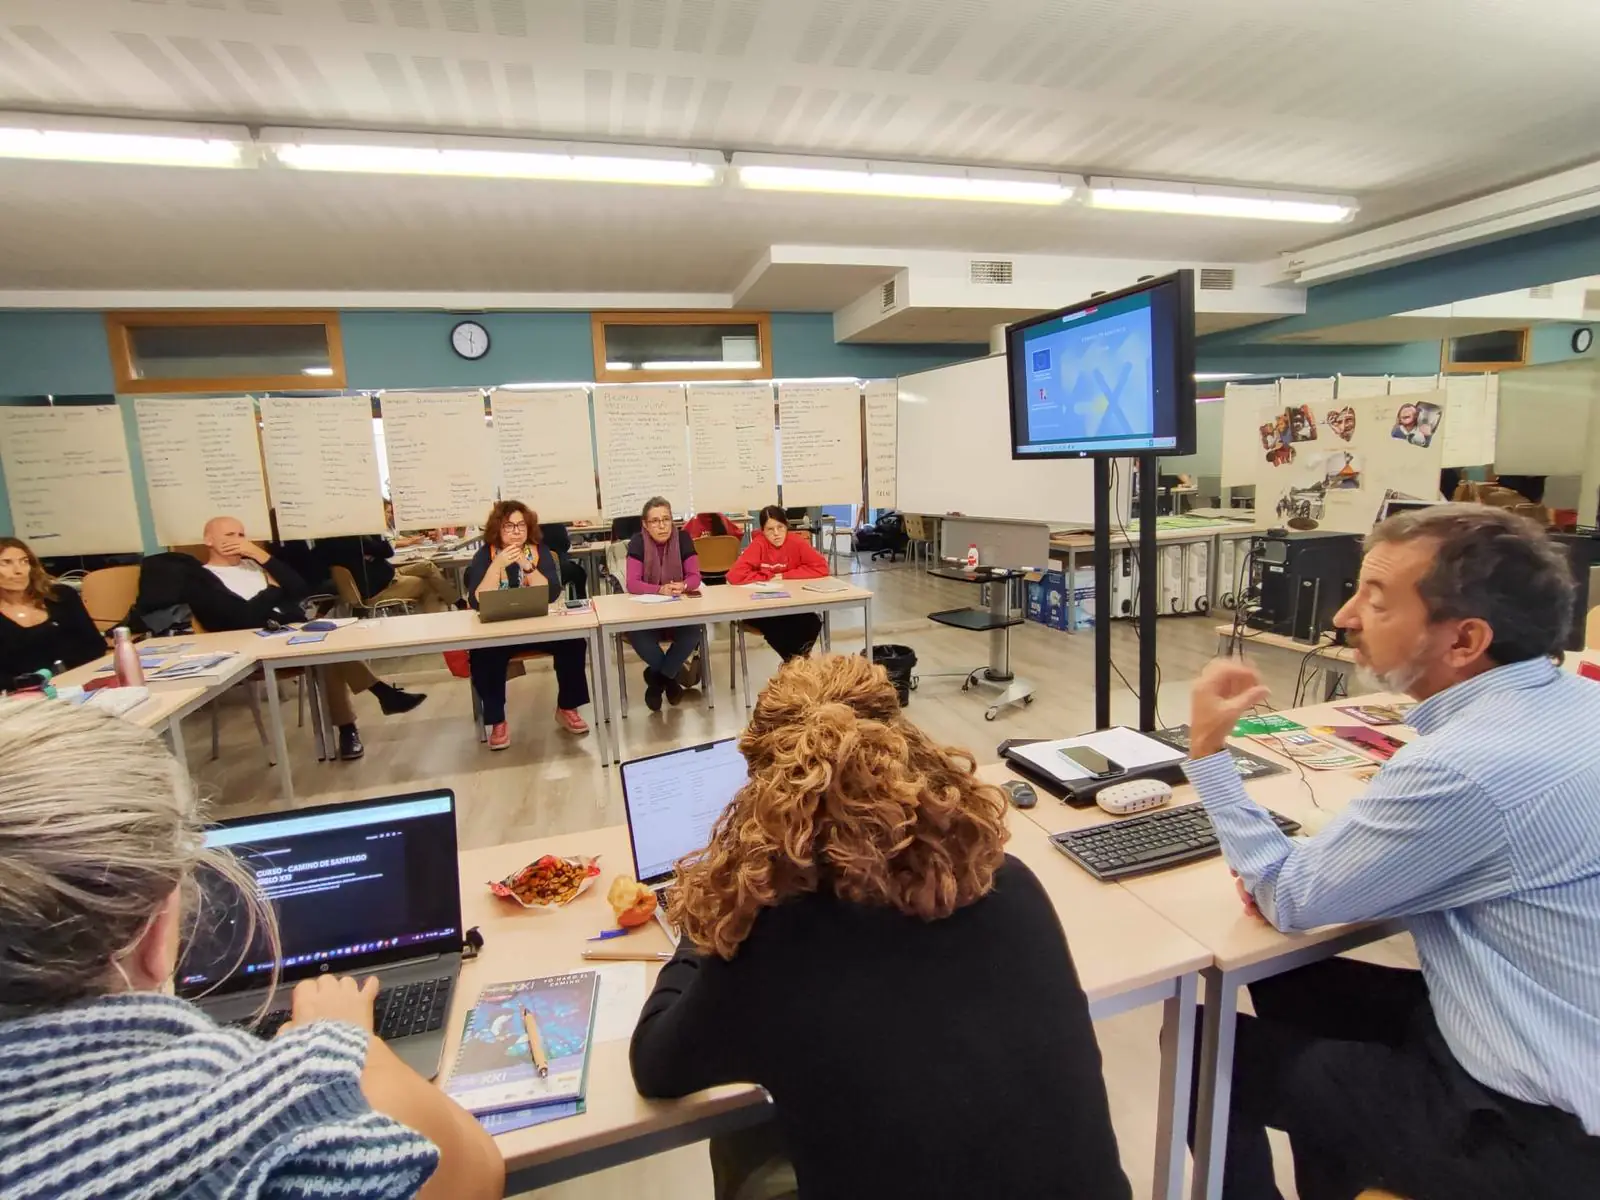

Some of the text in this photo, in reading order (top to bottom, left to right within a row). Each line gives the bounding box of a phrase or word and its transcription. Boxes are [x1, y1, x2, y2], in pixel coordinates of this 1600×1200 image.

[256, 867, 282, 878] CURSO
[287, 862, 319, 873] CAMINO
[319, 860, 330, 868] DE
[330, 854, 367, 866] SANTIAGO
[256, 874, 293, 885] SIGLO XXI
